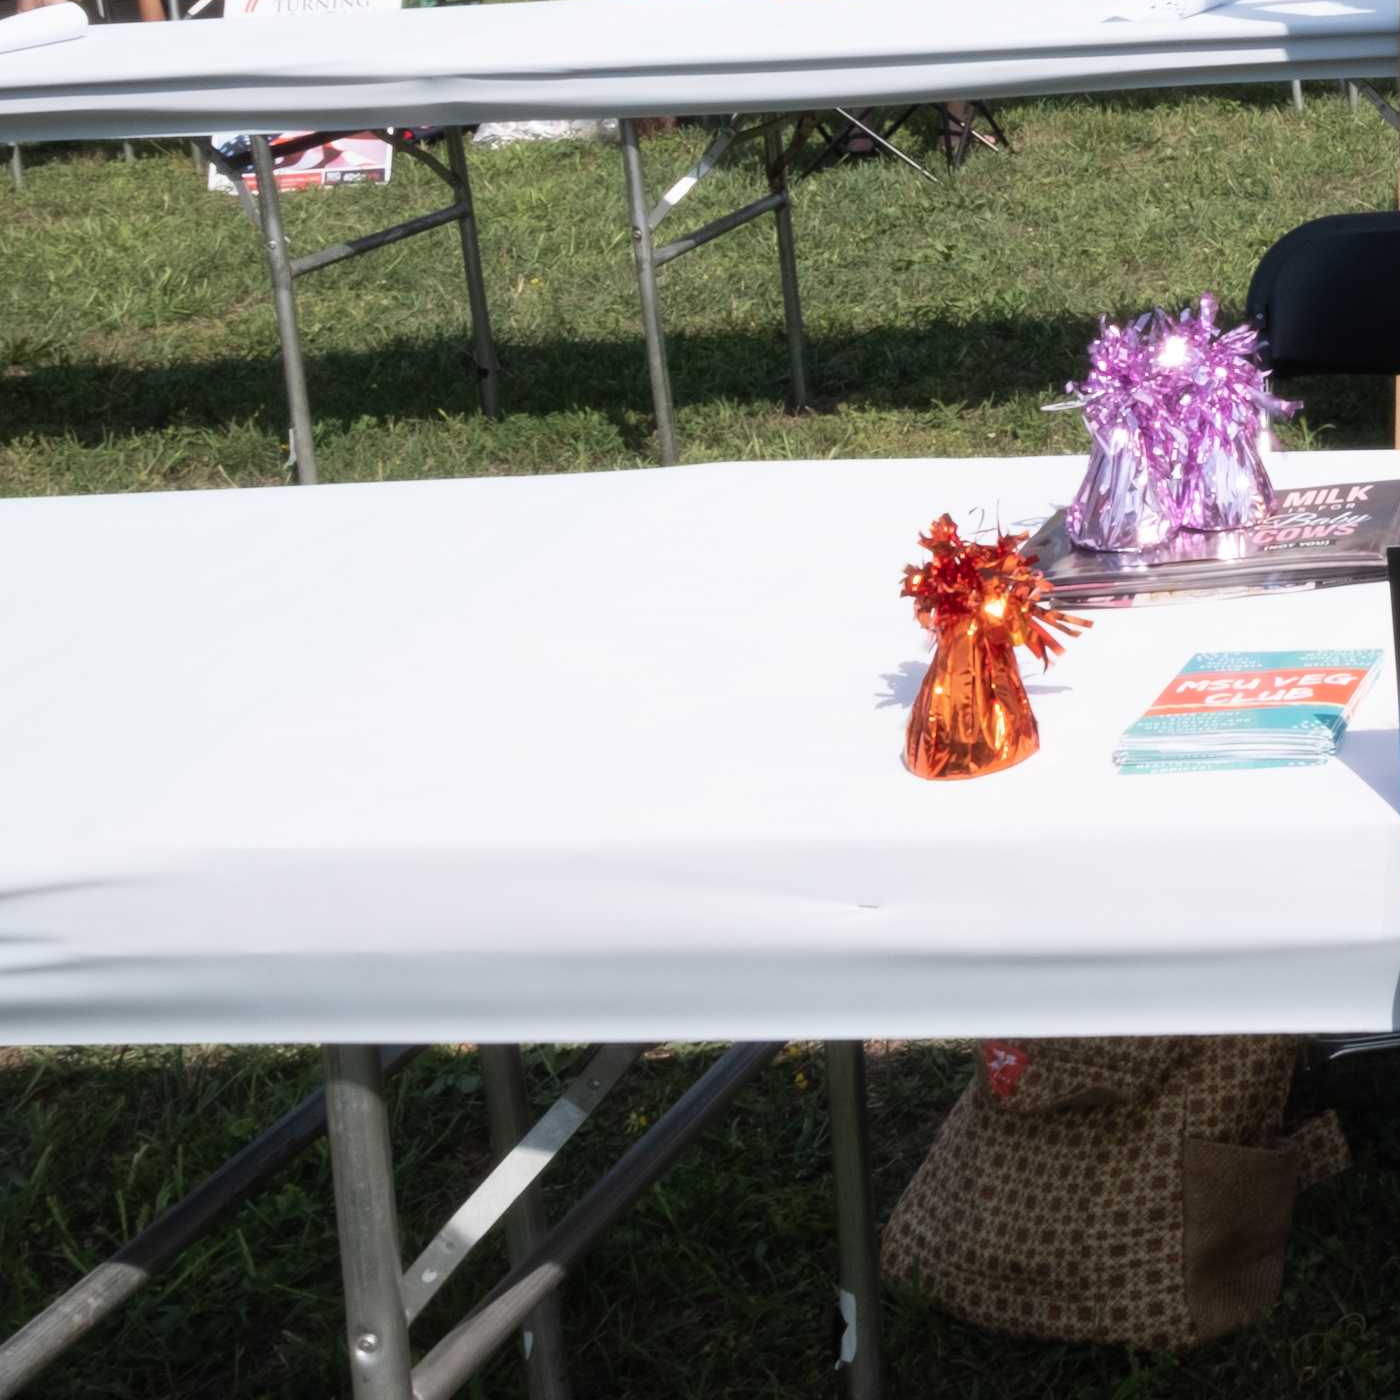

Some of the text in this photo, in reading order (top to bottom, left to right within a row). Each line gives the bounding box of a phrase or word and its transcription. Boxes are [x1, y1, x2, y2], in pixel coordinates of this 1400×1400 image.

[1282, 484, 1374, 508] MILK
[1318, 502, 1357, 512] FOR
[1252, 522, 1360, 545] COWS
[1263, 541, 1296, 551] (NOT
[1175, 673, 1359, 693] MSU VEG
[1204, 687, 1315, 705] CLUB
